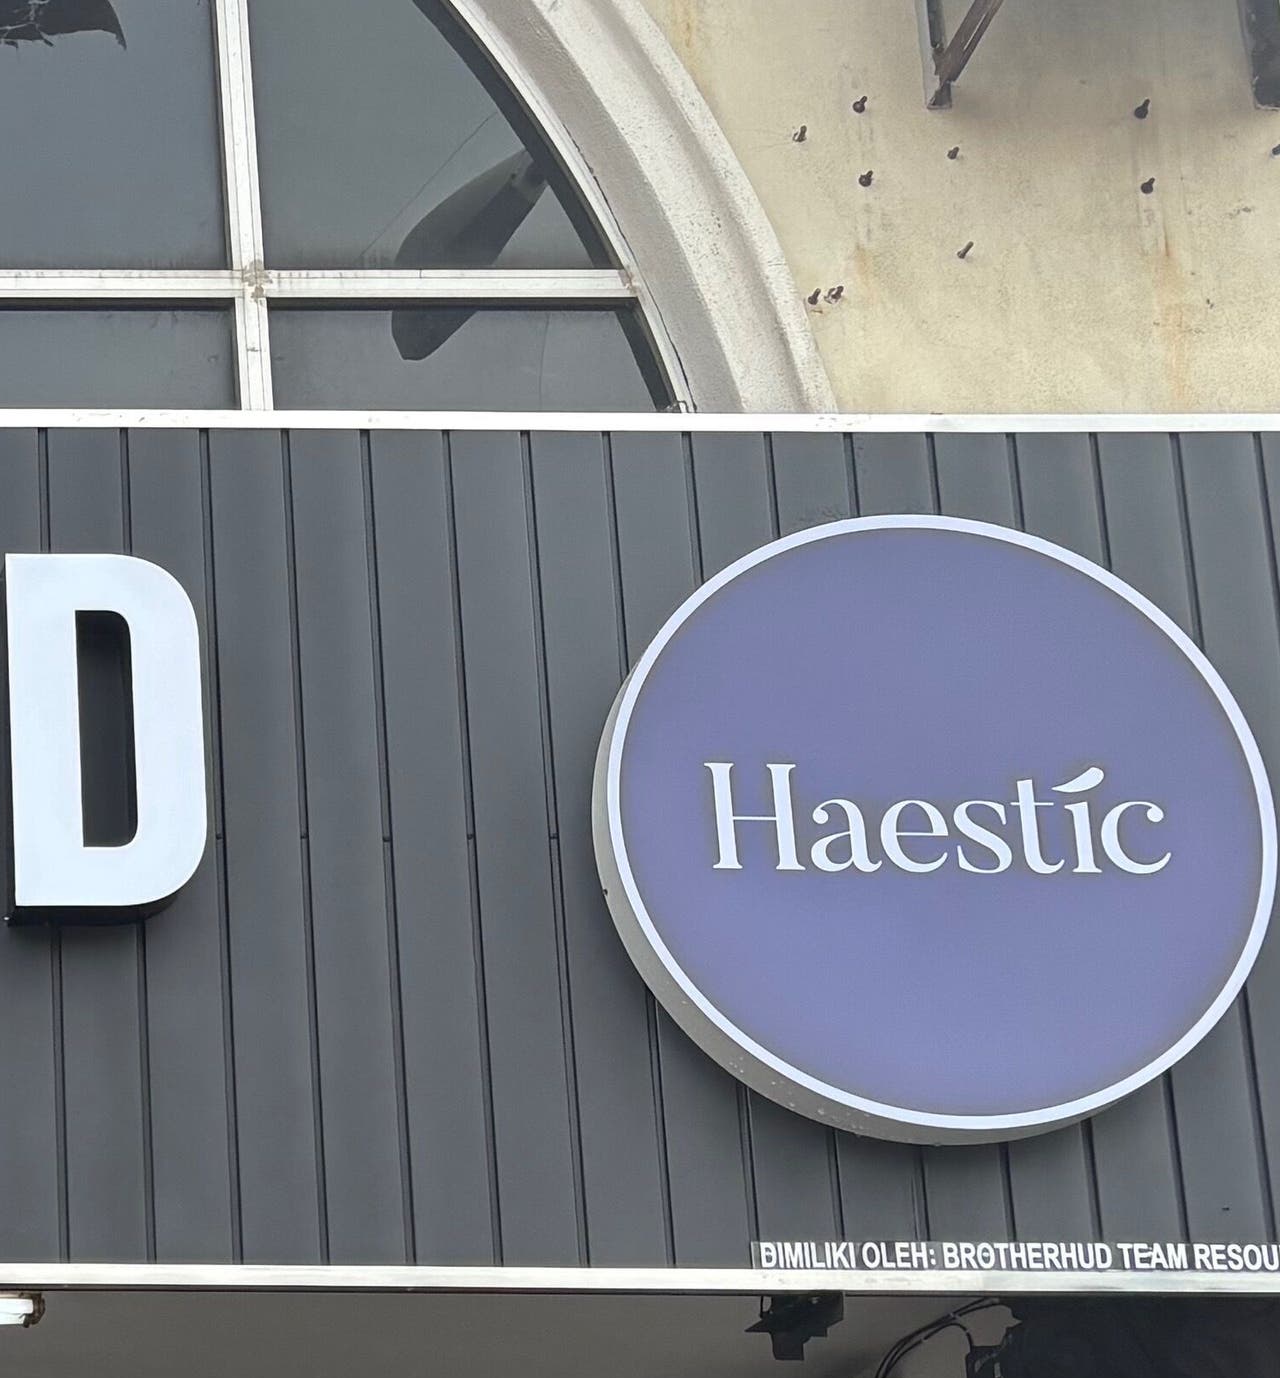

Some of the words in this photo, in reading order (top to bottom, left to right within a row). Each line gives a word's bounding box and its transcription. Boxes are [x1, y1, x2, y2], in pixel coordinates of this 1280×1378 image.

[760, 1241, 856, 1269] DIMILIKI
[862, 1242, 937, 1269] OLEH:
[943, 1241, 1112, 1270] BROTHERHUD
[1117, 1243, 1188, 1270] TEAM
[1193, 1243, 1280, 1271] RESOU
